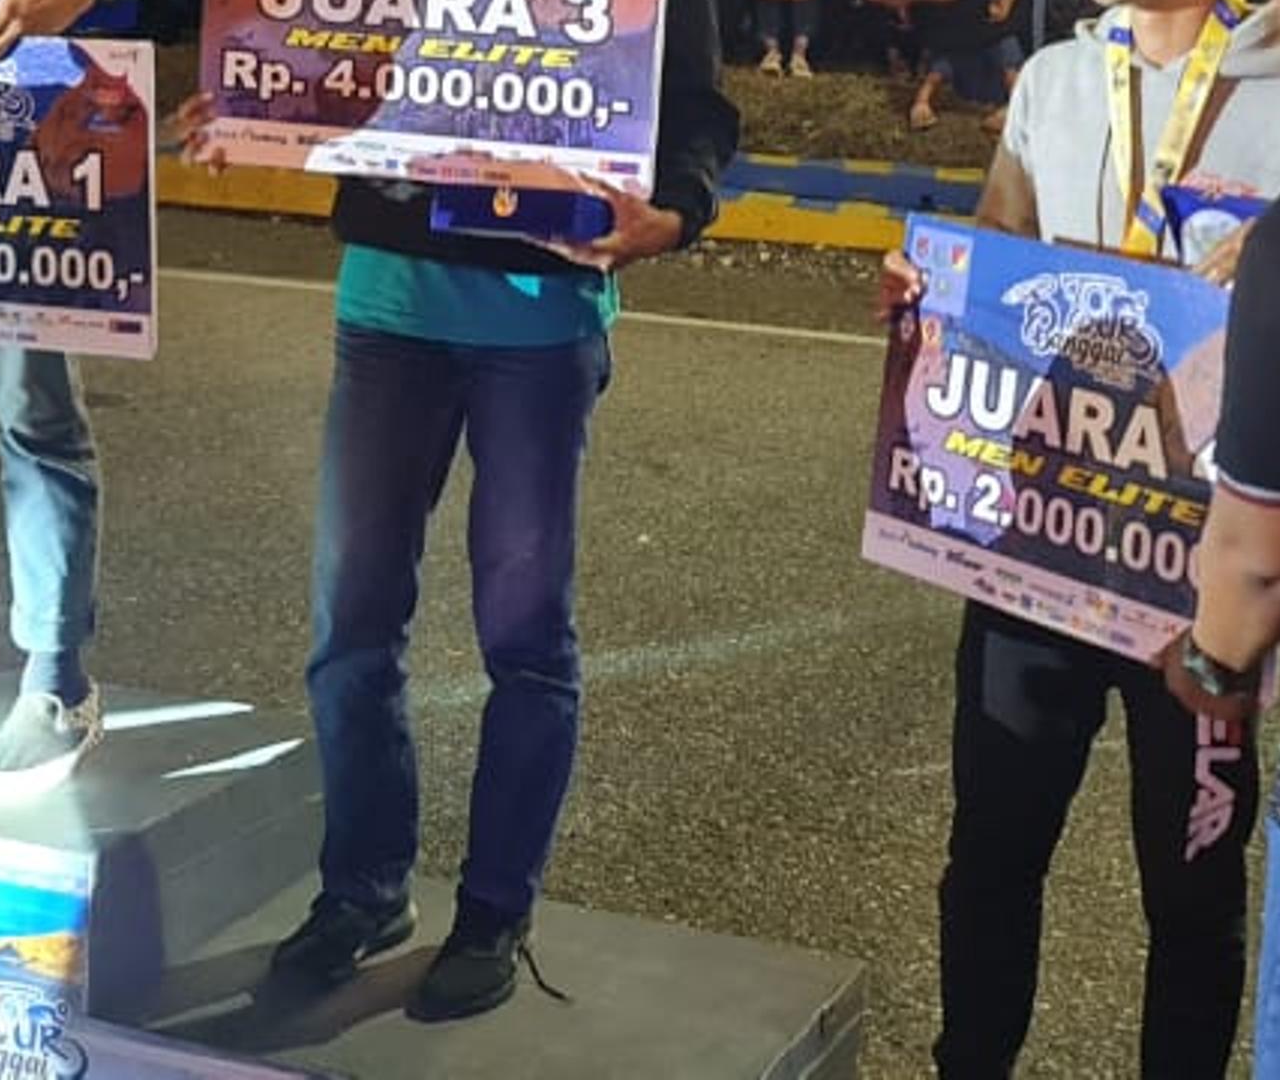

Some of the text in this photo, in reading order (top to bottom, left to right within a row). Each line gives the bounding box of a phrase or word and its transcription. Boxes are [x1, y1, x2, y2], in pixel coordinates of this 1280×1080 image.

[223, 51, 630, 127] Rp. 4.000.000,-
[285, 28, 579, 69] MEN ELITE
[72, 153, 103, 211] 1
[926, 354, 1167, 479] JUARA
[889, 447, 1199, 583] Rp. 2.000.00
[945, 431, 1206, 527] MEN ELITE
